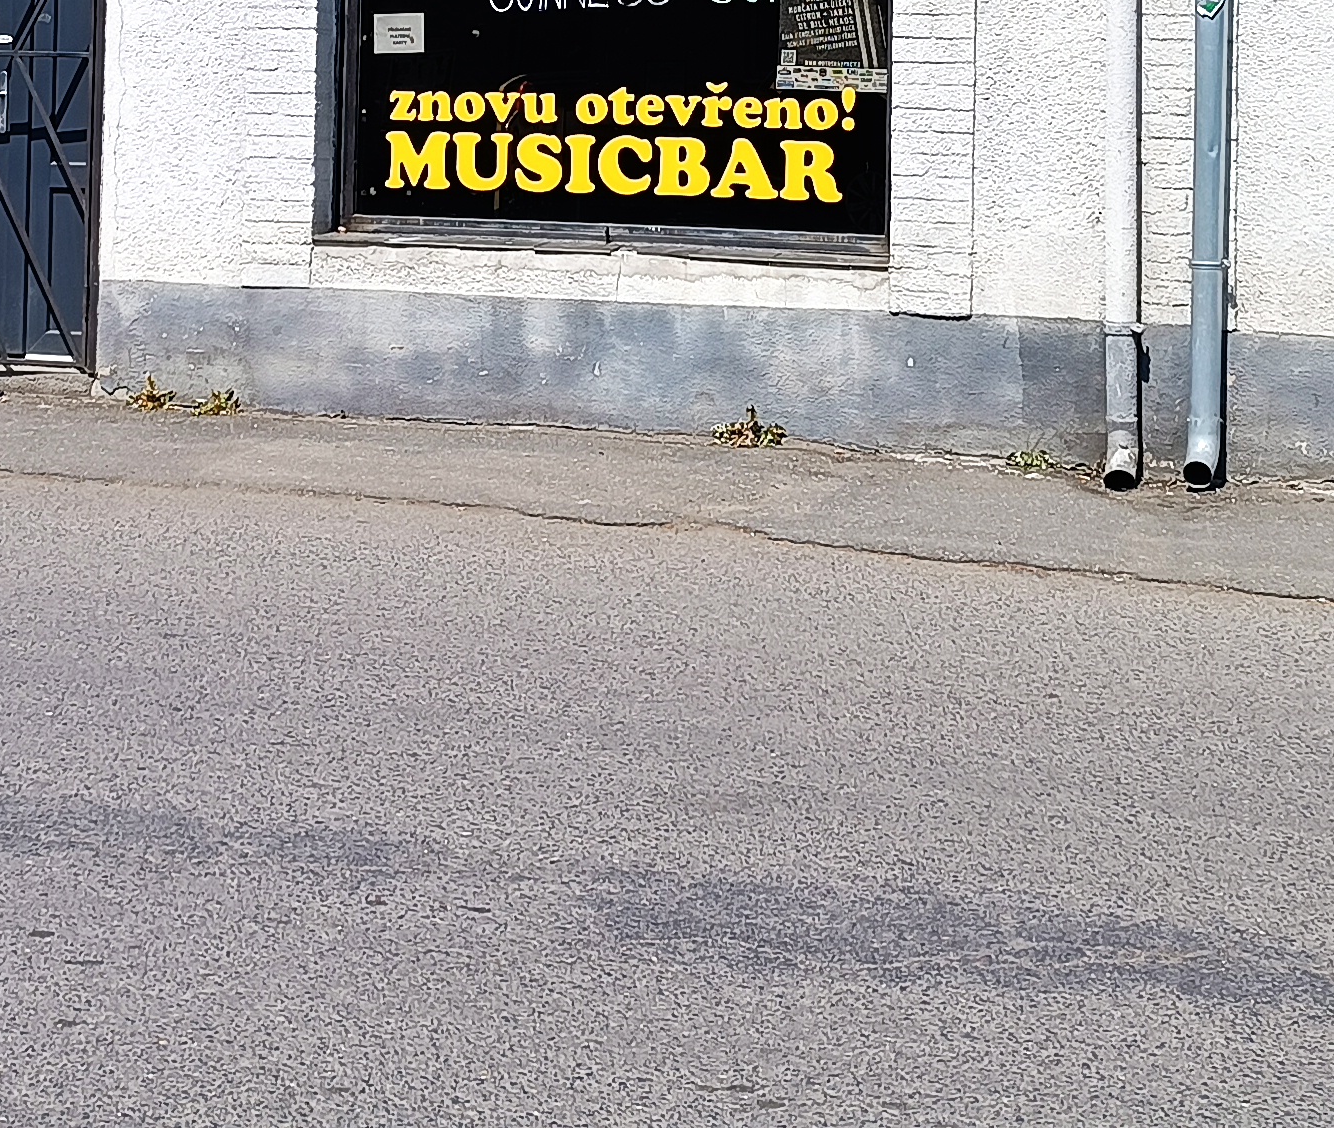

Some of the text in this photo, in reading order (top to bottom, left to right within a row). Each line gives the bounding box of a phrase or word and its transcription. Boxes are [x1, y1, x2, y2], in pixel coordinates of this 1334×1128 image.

[389, 81, 857, 132] znovu otevřeno!
[385, 130, 844, 203] MUSICBAR
